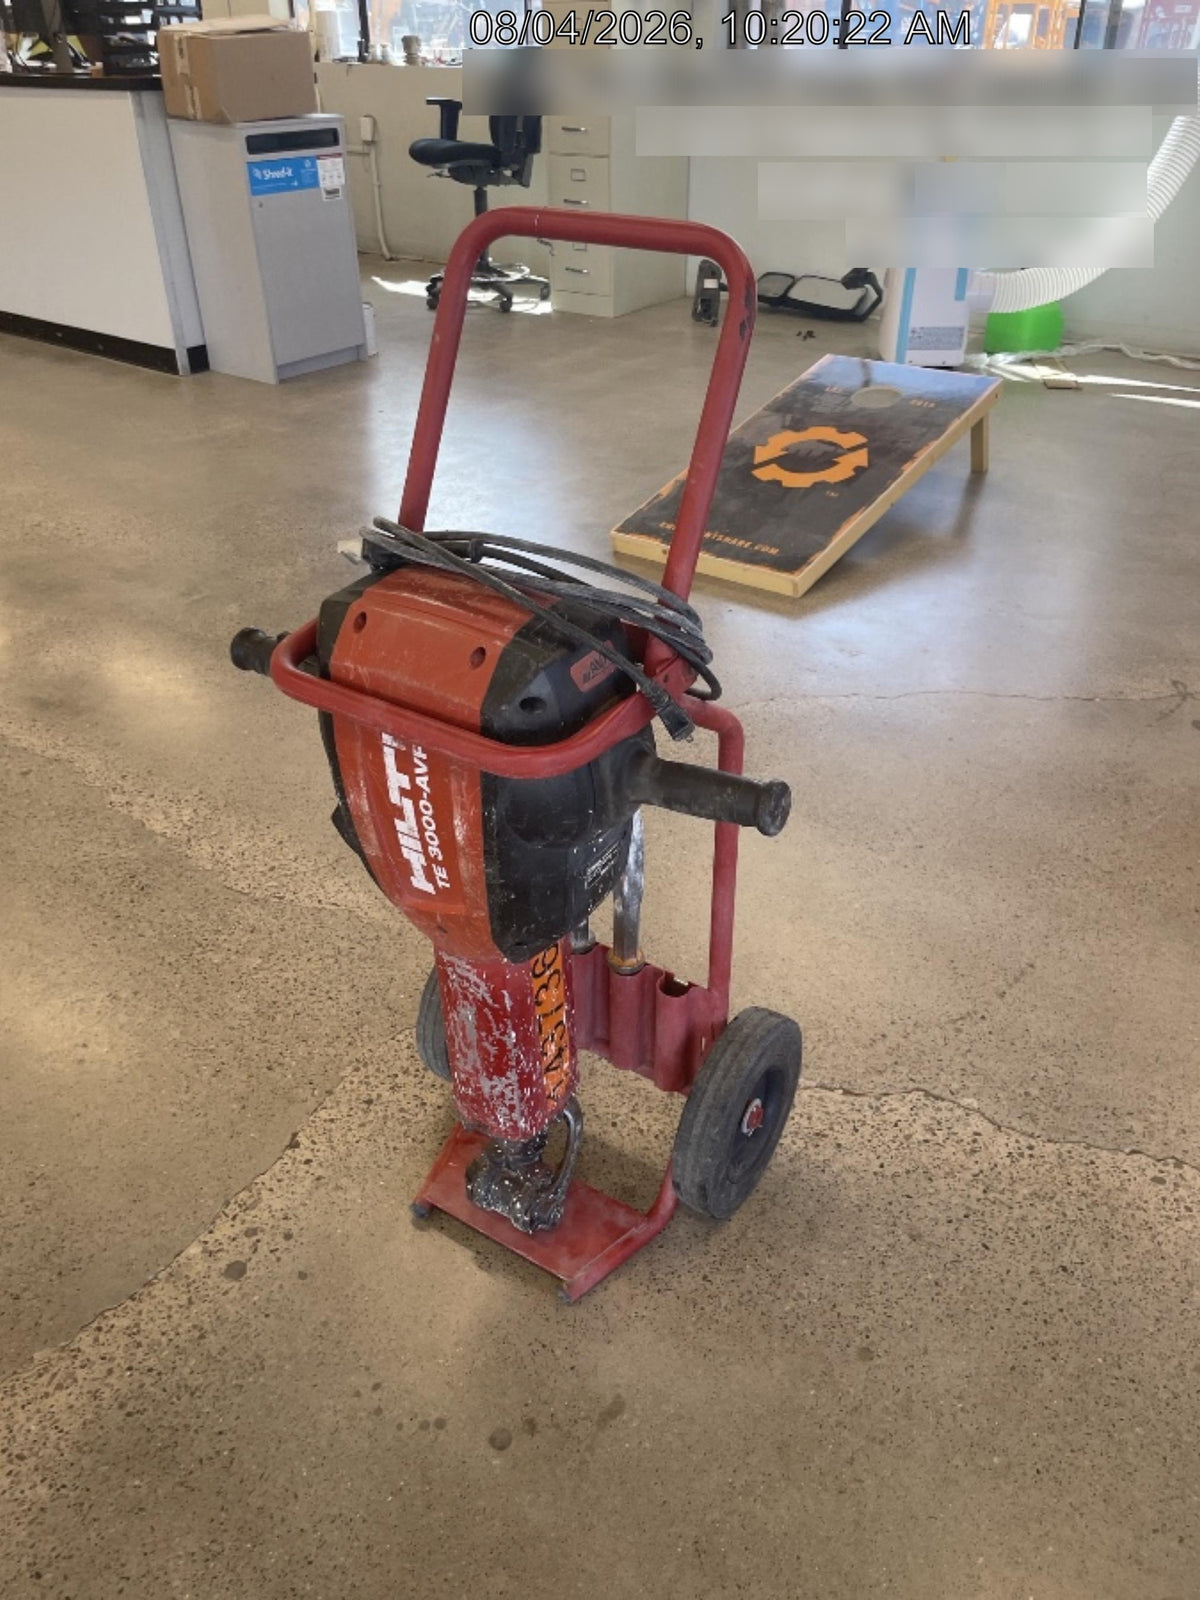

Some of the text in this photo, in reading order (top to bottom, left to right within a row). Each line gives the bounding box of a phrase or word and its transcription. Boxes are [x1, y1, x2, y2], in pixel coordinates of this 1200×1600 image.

[381, 731, 437, 895] HILTI
[412, 743, 451, 889] TE 3000-AVF
